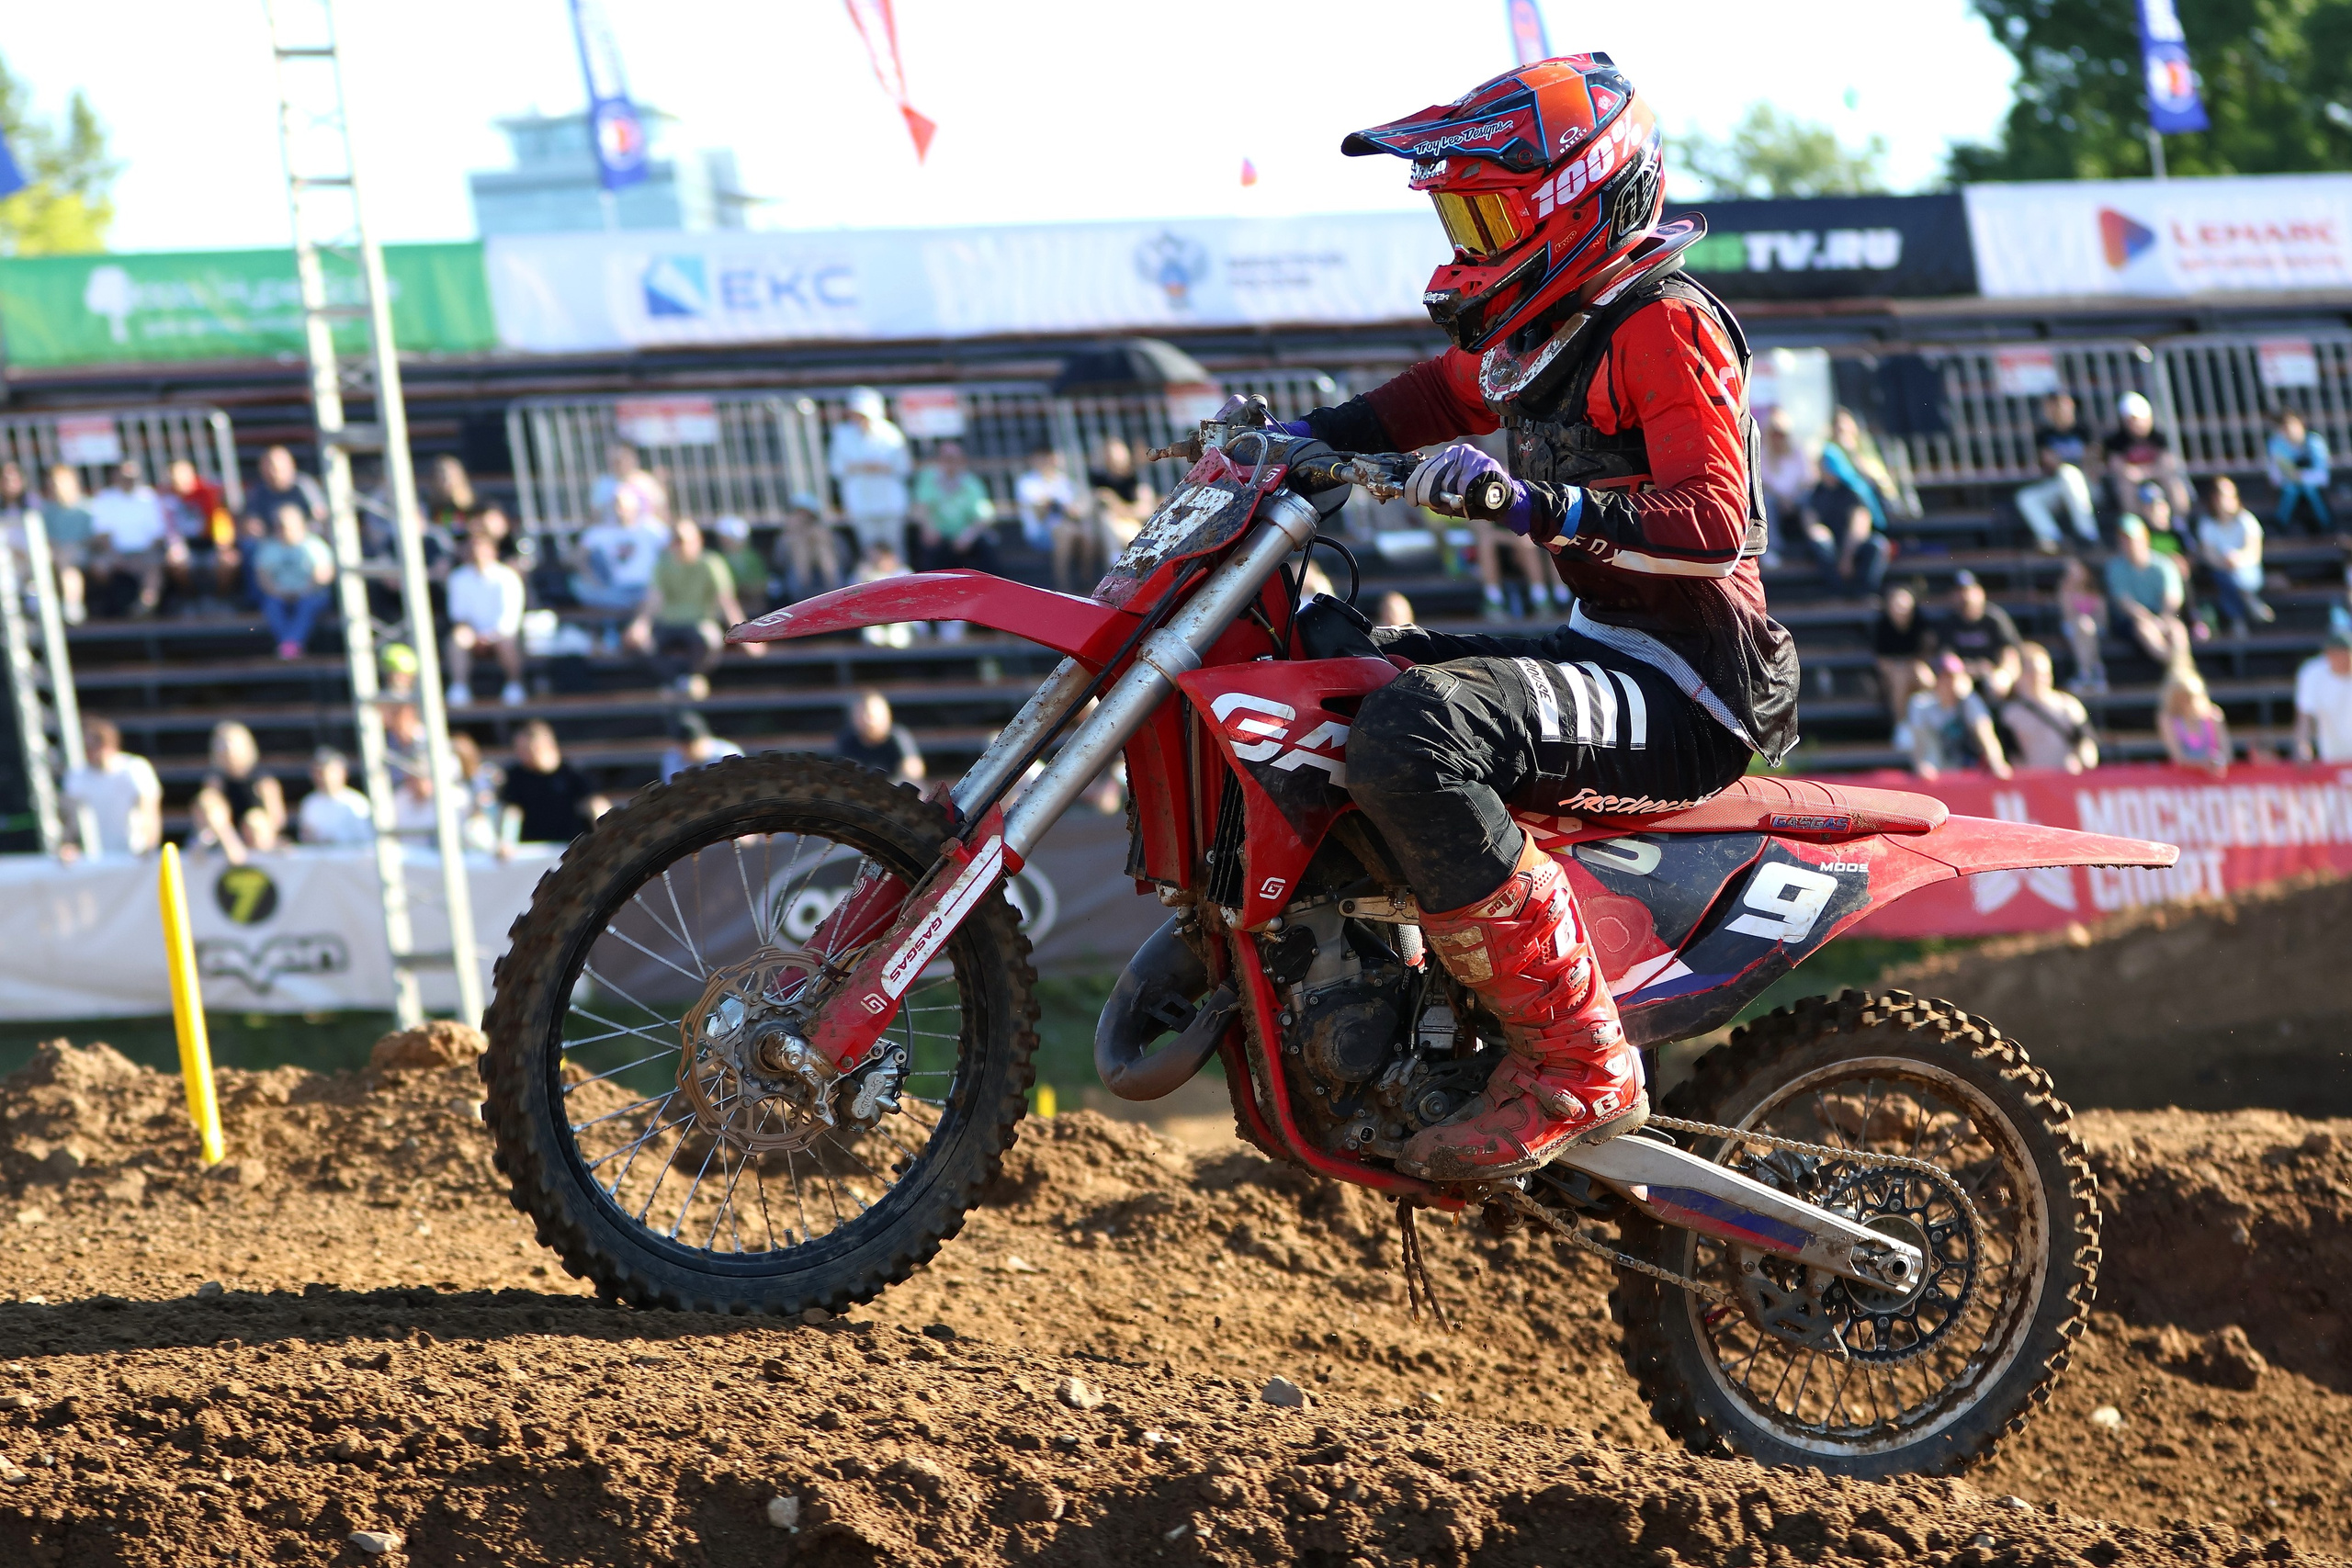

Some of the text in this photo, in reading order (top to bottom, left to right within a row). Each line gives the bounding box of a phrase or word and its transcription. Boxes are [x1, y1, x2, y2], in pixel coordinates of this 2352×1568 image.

[1414, 120, 1513, 156] Troy Lee Designs
[1531, 107, 1643, 220] 100%
[1559, 127, 1588, 154] OAKLEY
[1771, 814, 1849, 831] GASGAS
[1724, 860, 1839, 944] 9
[889, 916, 944, 983] GASGAS
